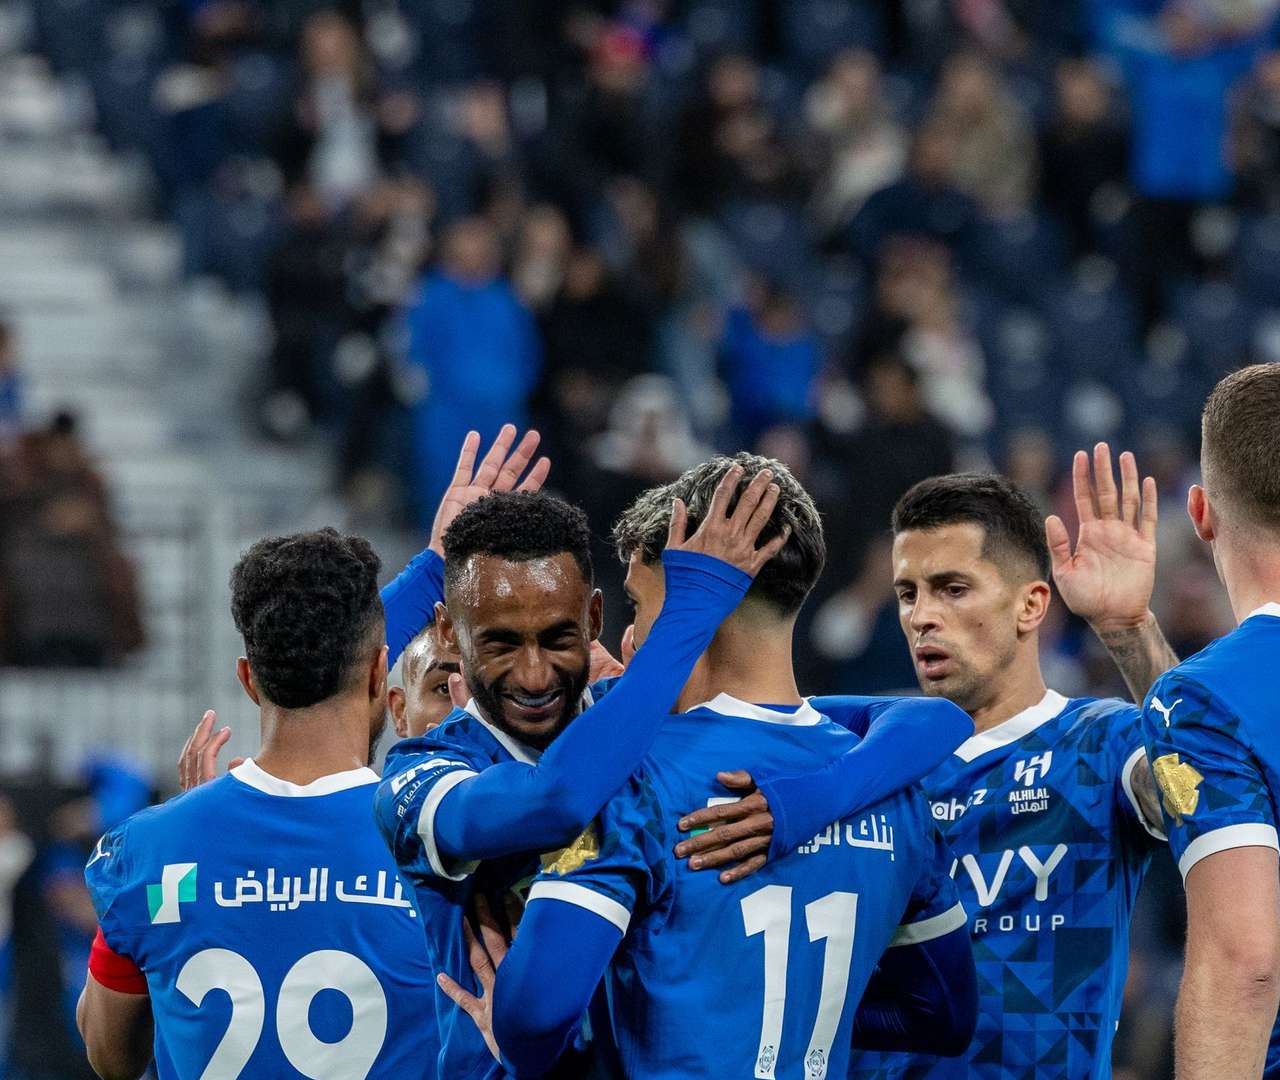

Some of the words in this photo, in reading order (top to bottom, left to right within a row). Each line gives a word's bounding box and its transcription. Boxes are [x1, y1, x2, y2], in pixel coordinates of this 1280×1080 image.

[1009, 788, 1050, 802] ALHILAL
[846, 813, 895, 861] بنك
[214, 867, 329, 911] الرياض
[973, 914, 1065, 933] ROUP
